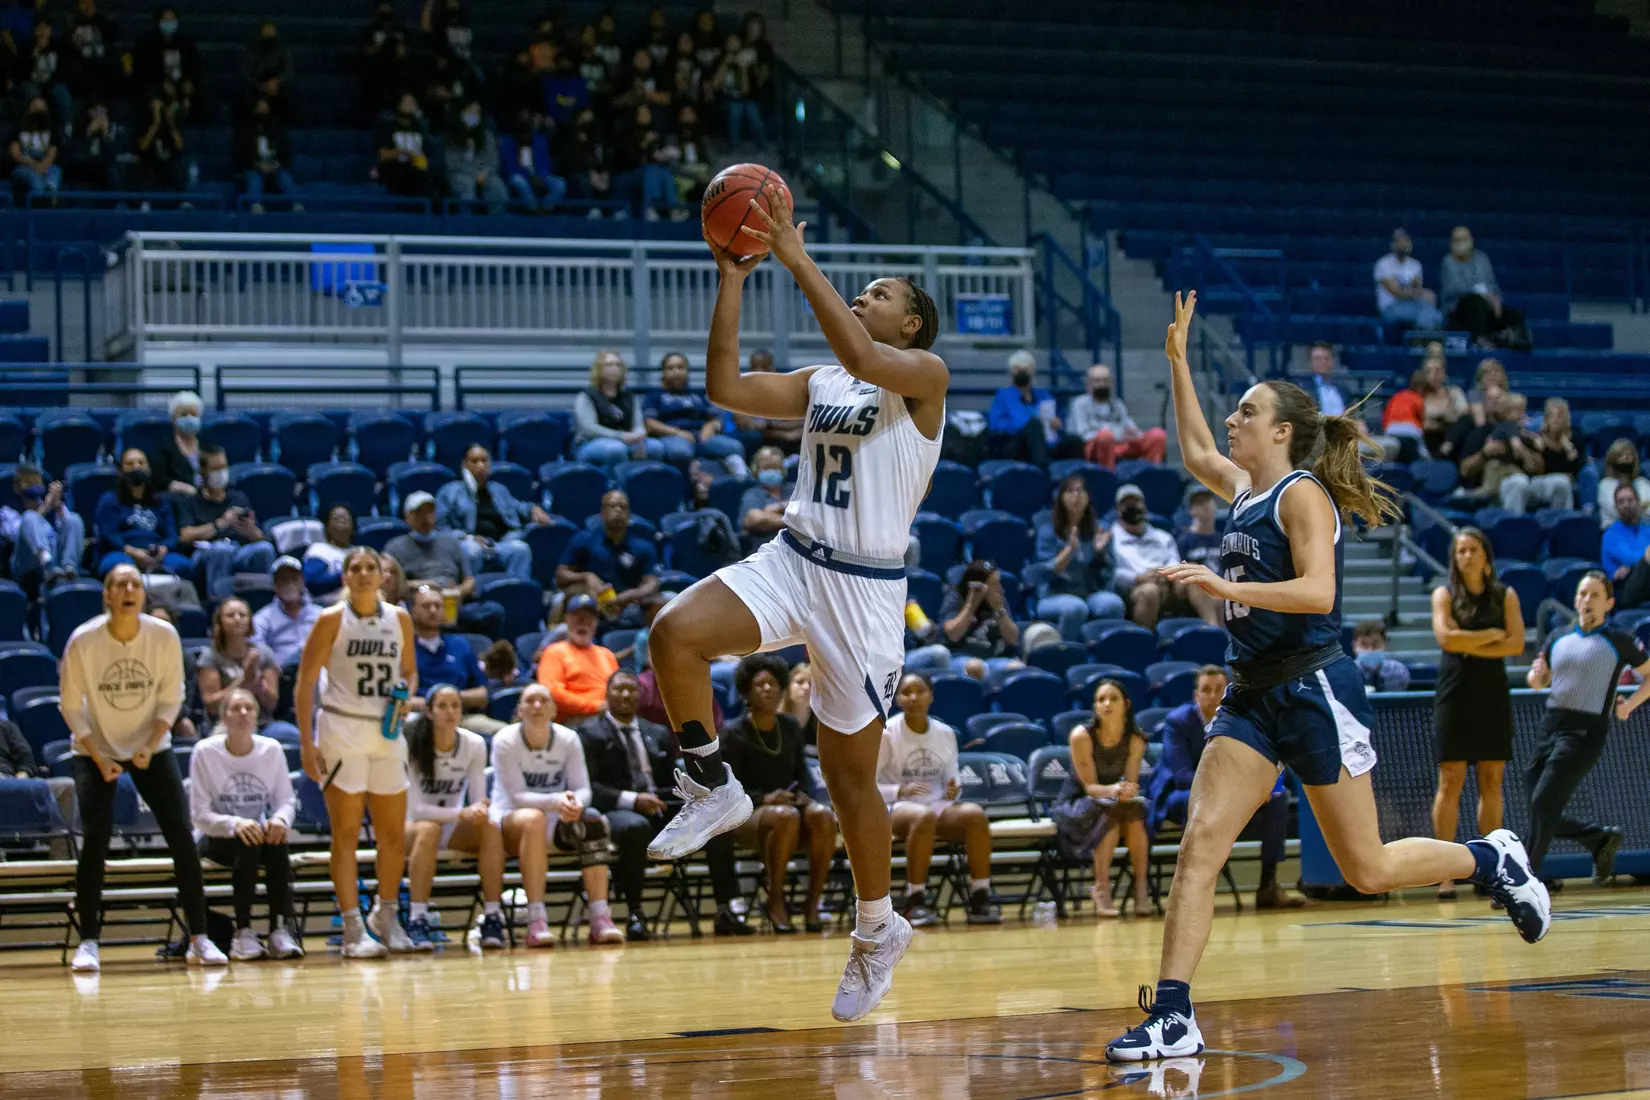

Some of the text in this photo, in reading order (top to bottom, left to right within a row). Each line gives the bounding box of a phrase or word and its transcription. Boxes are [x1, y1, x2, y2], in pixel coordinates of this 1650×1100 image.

[808, 403, 880, 436] OWLS
[811, 443, 851, 509] 12
[346, 638, 399, 658] OWLS
[356, 662, 392, 696] 22
